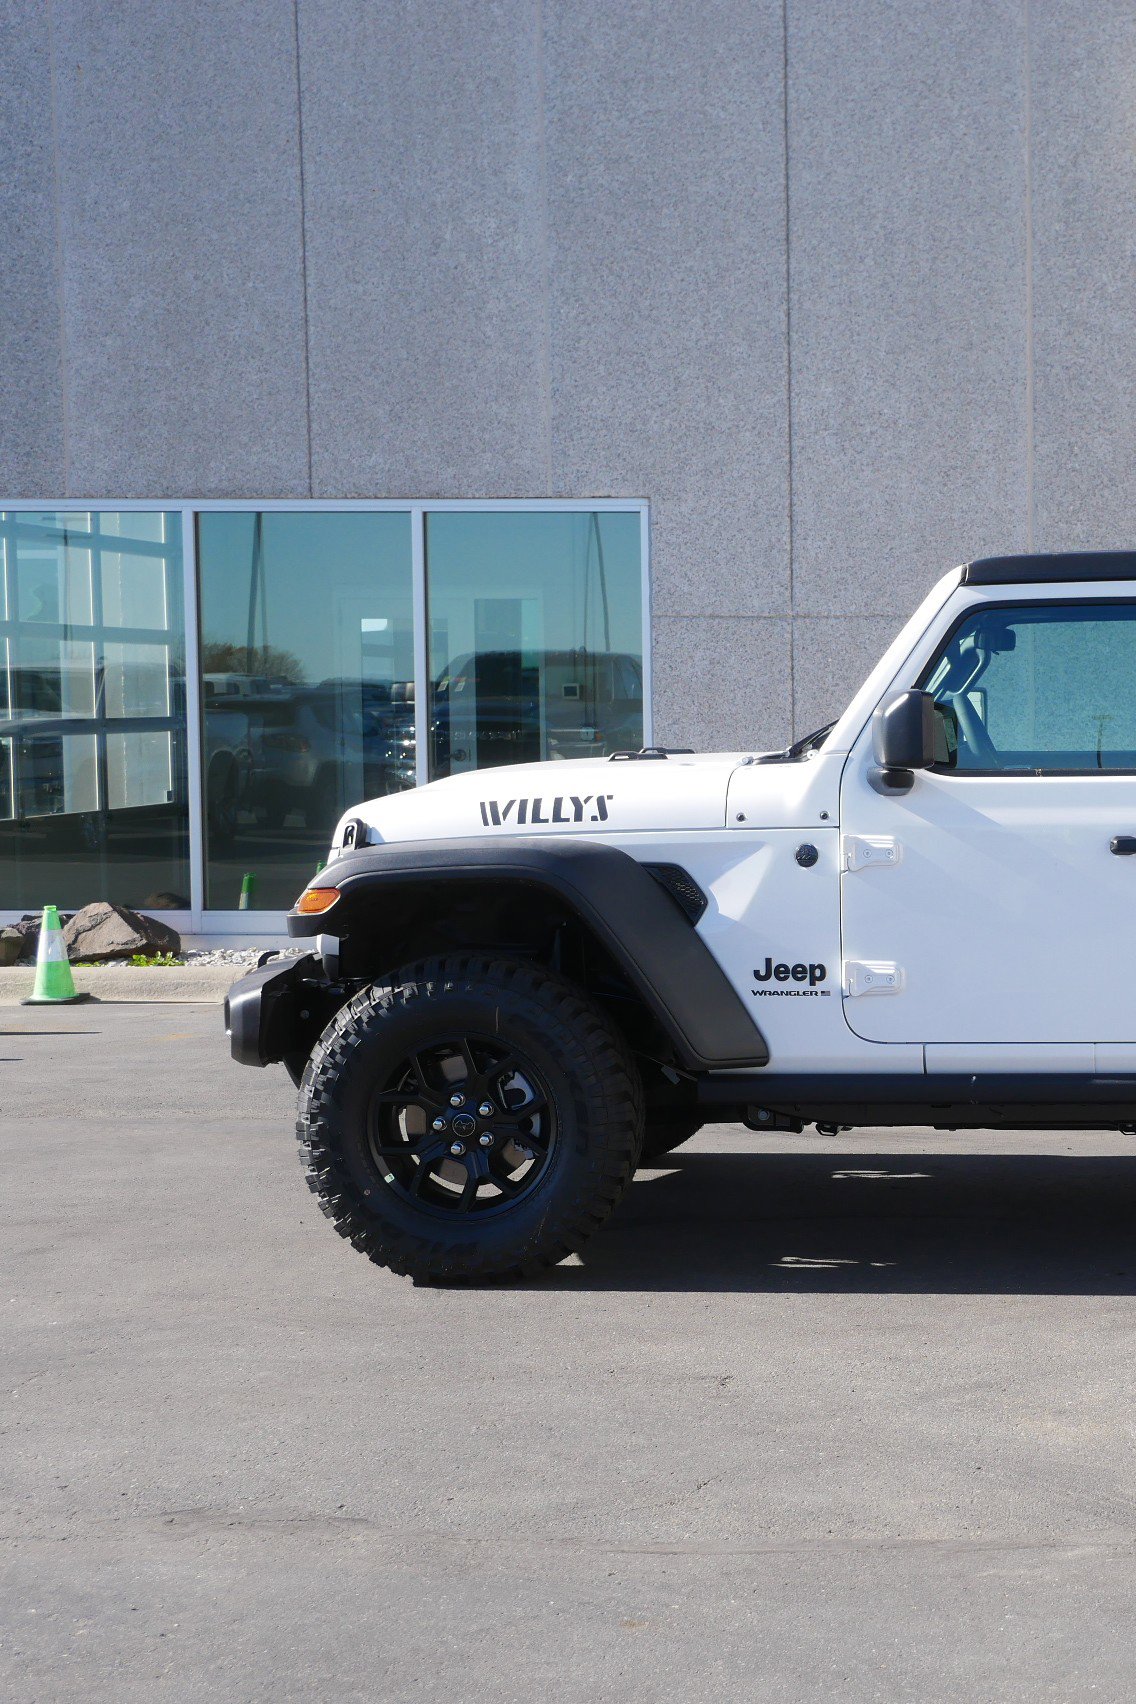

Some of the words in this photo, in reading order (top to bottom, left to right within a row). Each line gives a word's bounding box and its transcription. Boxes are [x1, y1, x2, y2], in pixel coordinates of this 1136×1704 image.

[479, 794, 614, 827] WILLYS
[753, 957, 827, 986] Jeep
[750, 989, 819, 997] WRANGLER
